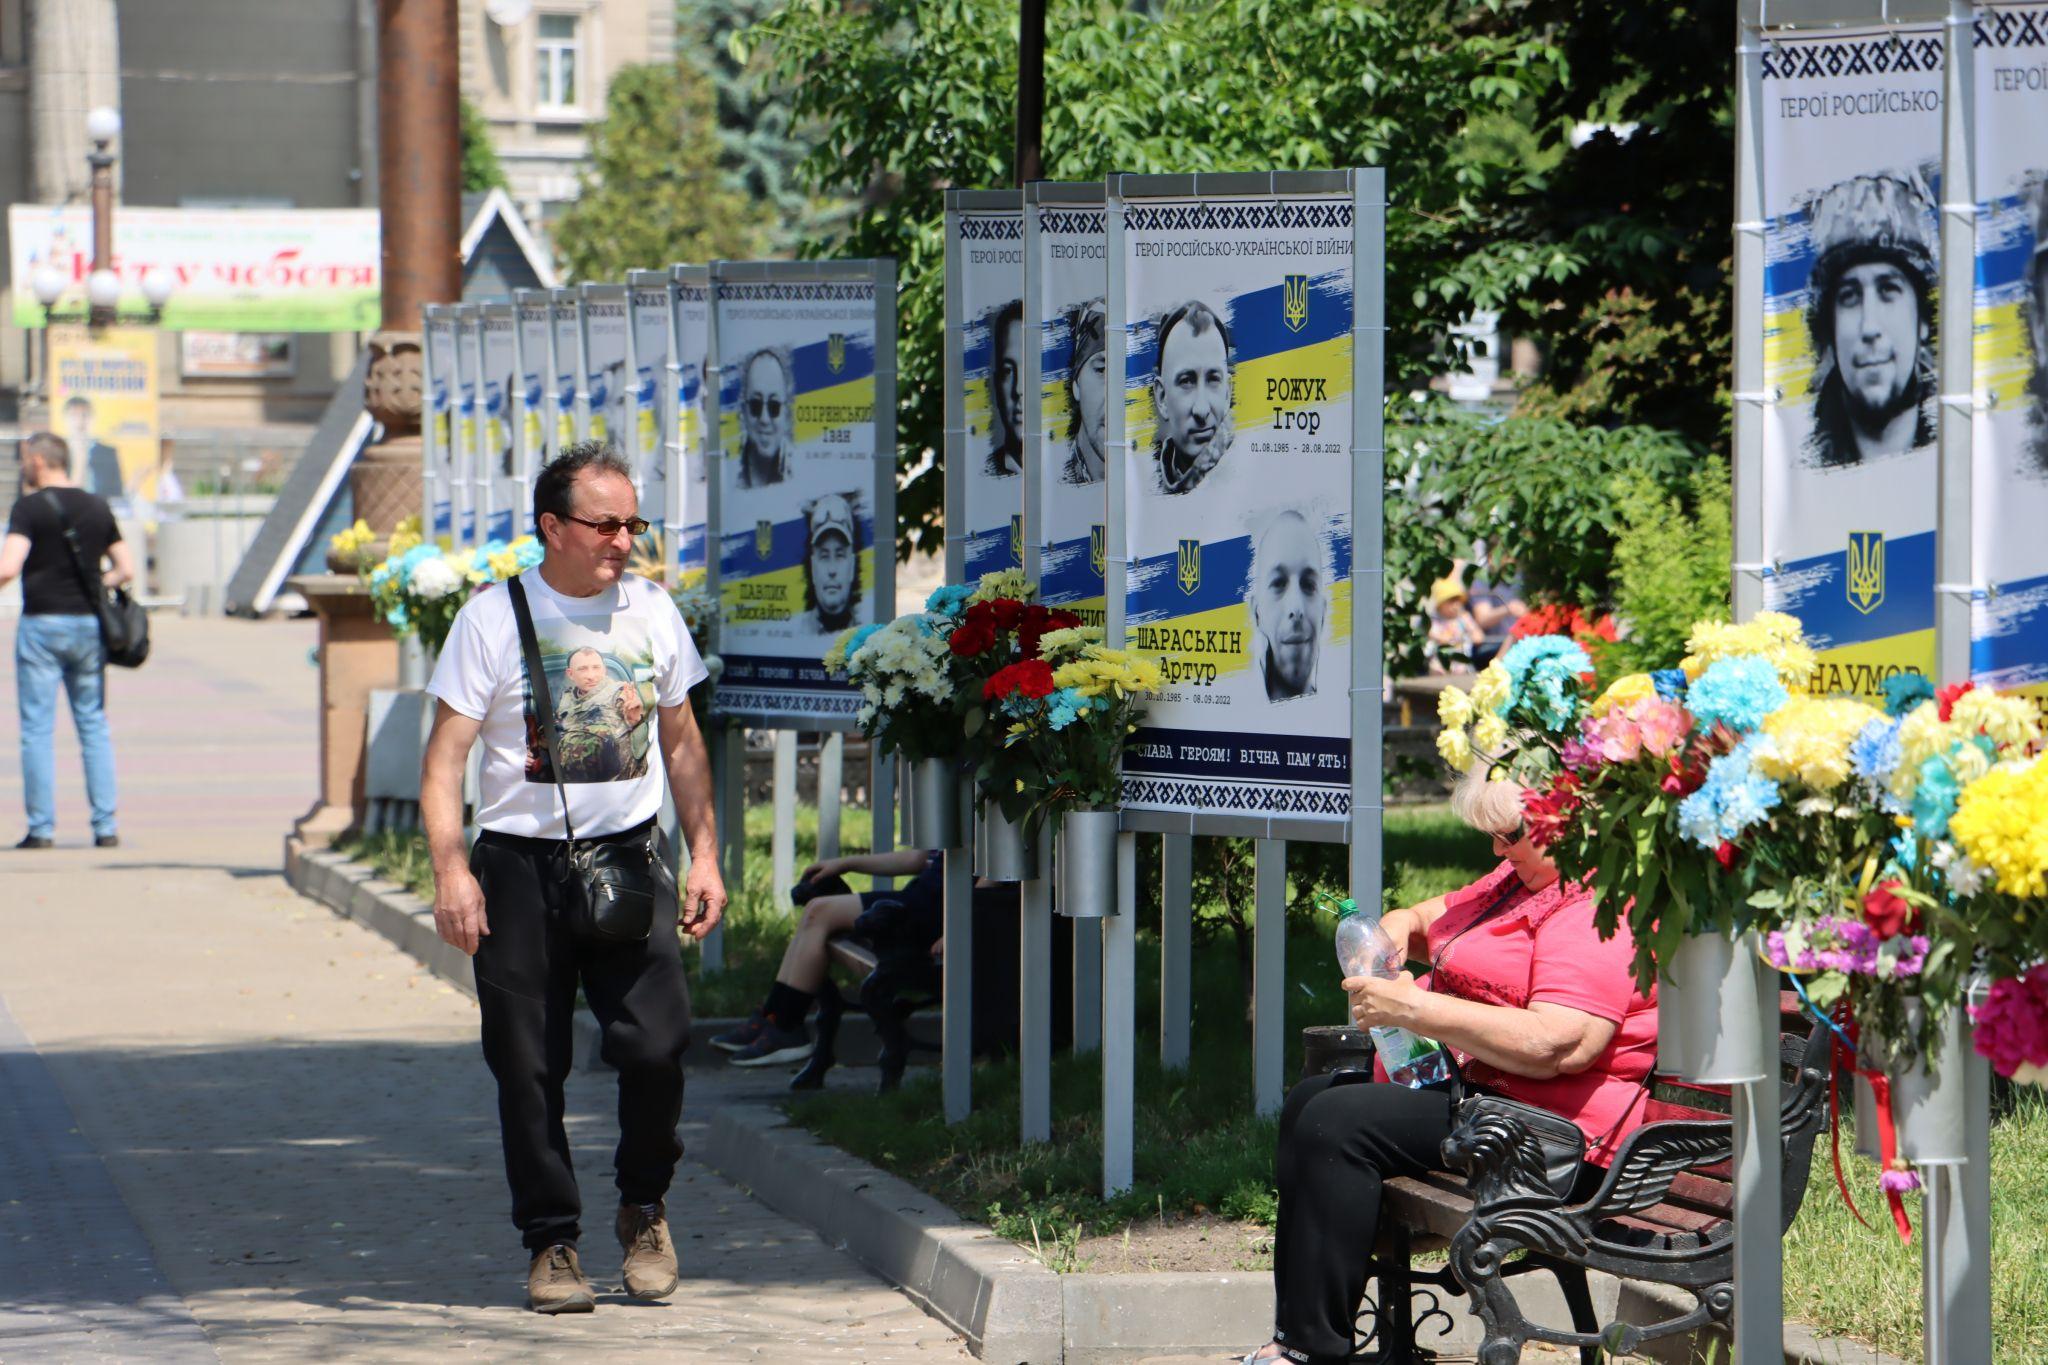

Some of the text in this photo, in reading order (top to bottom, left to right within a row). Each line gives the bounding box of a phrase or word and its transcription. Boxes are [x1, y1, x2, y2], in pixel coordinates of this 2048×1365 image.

[1780, 91, 1827, 118] ГЕРОЇ
[970, 247, 996, 264] ГЕРОЇ
[1051, 242, 1078, 259] ГЕРОЇ
[1135, 237, 1353, 257] ГЕРОЇ РОСІЙСЬКО-УКРАЇНСЬКОЇ ВІЙНИ
[1266, 377, 1327, 401] РОЖУК
[1273, 406, 1321, 435] Ігор
[1250, 442, 1290, 453] 01.08.1985
[1301, 443, 1341, 454] 28.08.2022
[1137, 627, 1242, 654] ШАРАСЬКІН
[1160, 656, 1217, 687] Артур
[1180, 746, 1230, 763] ГЕРОЯМ!
[1240, 749, 1280, 766] ВІЧНА
